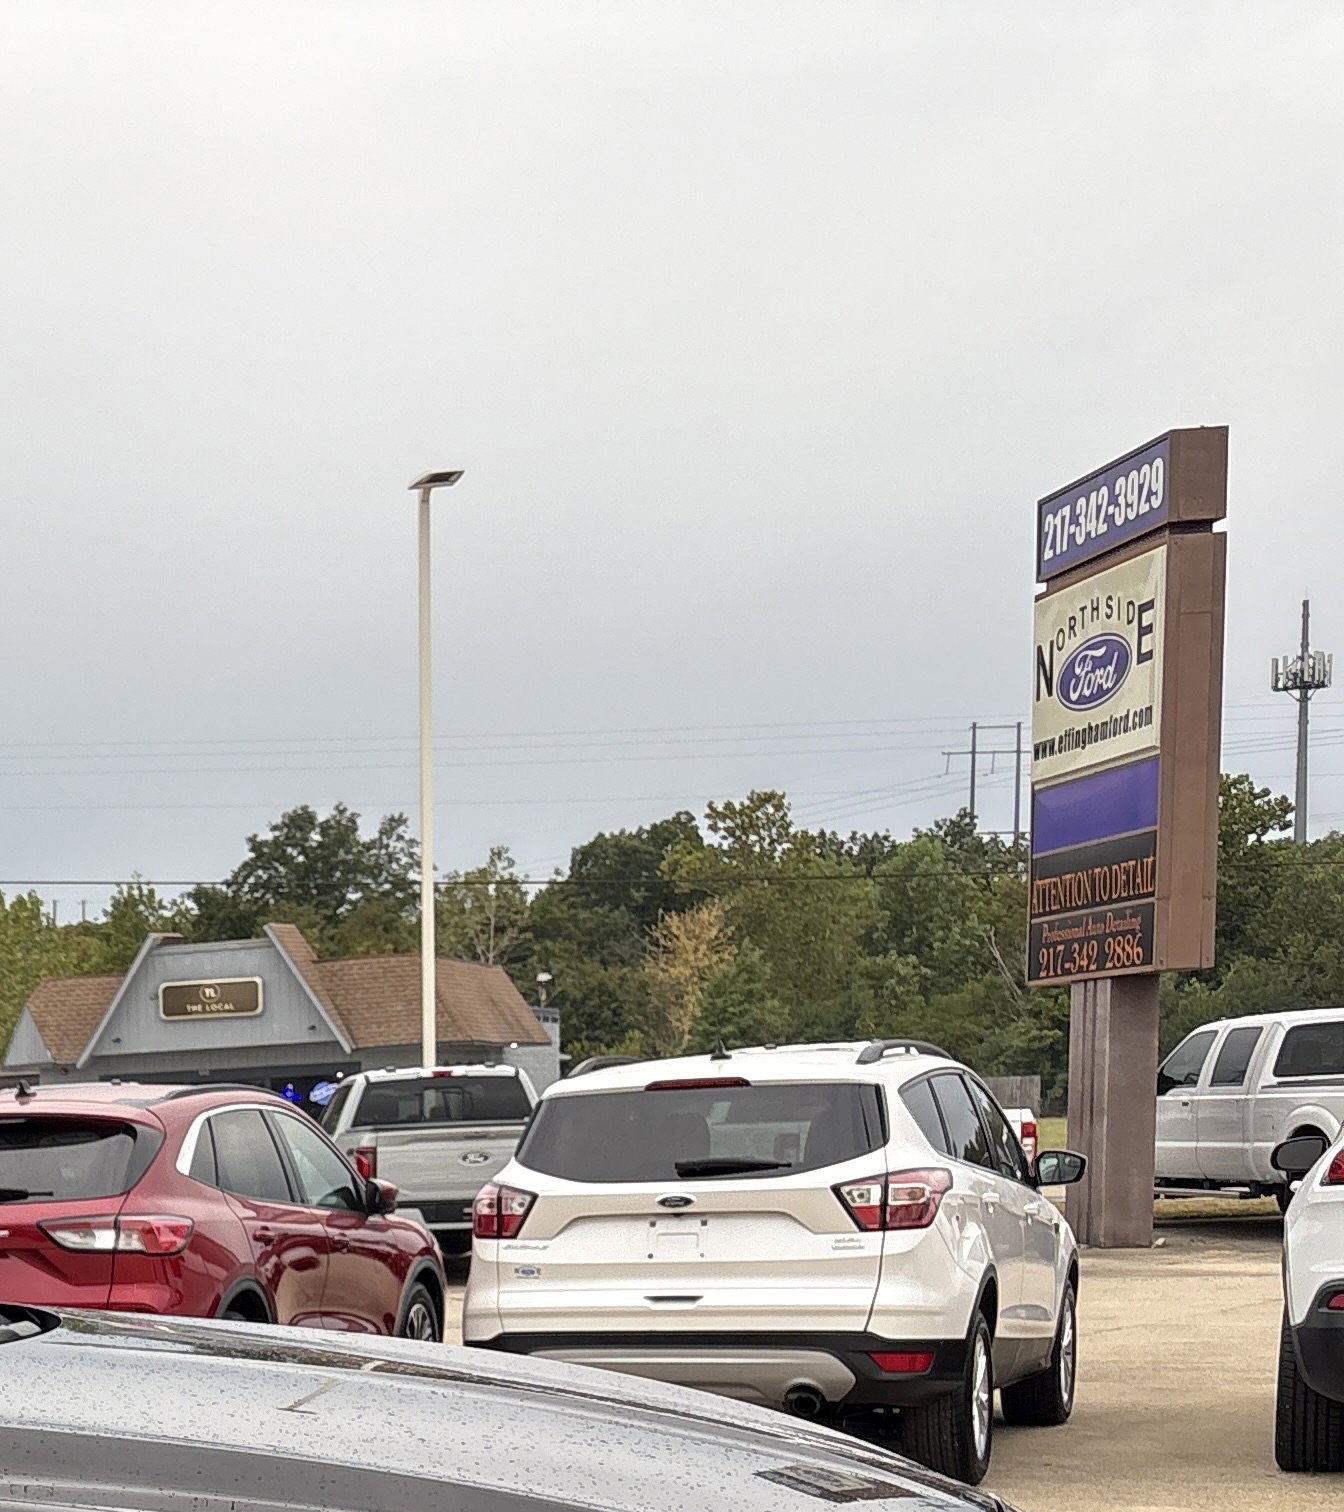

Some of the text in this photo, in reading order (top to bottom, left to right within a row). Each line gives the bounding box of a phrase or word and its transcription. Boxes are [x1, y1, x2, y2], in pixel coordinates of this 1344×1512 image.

[1043, 457, 1164, 561] 217-342-3929
[1036, 594, 1155, 702] NORTHSIDE
[1069, 645, 1119, 702] Ford
[1033, 705, 1153, 762] www.effinghamford.com
[1032, 855, 1155, 915] ATTENTION TO DETAIL
[1038, 932, 1144, 978] 217-342 2886
